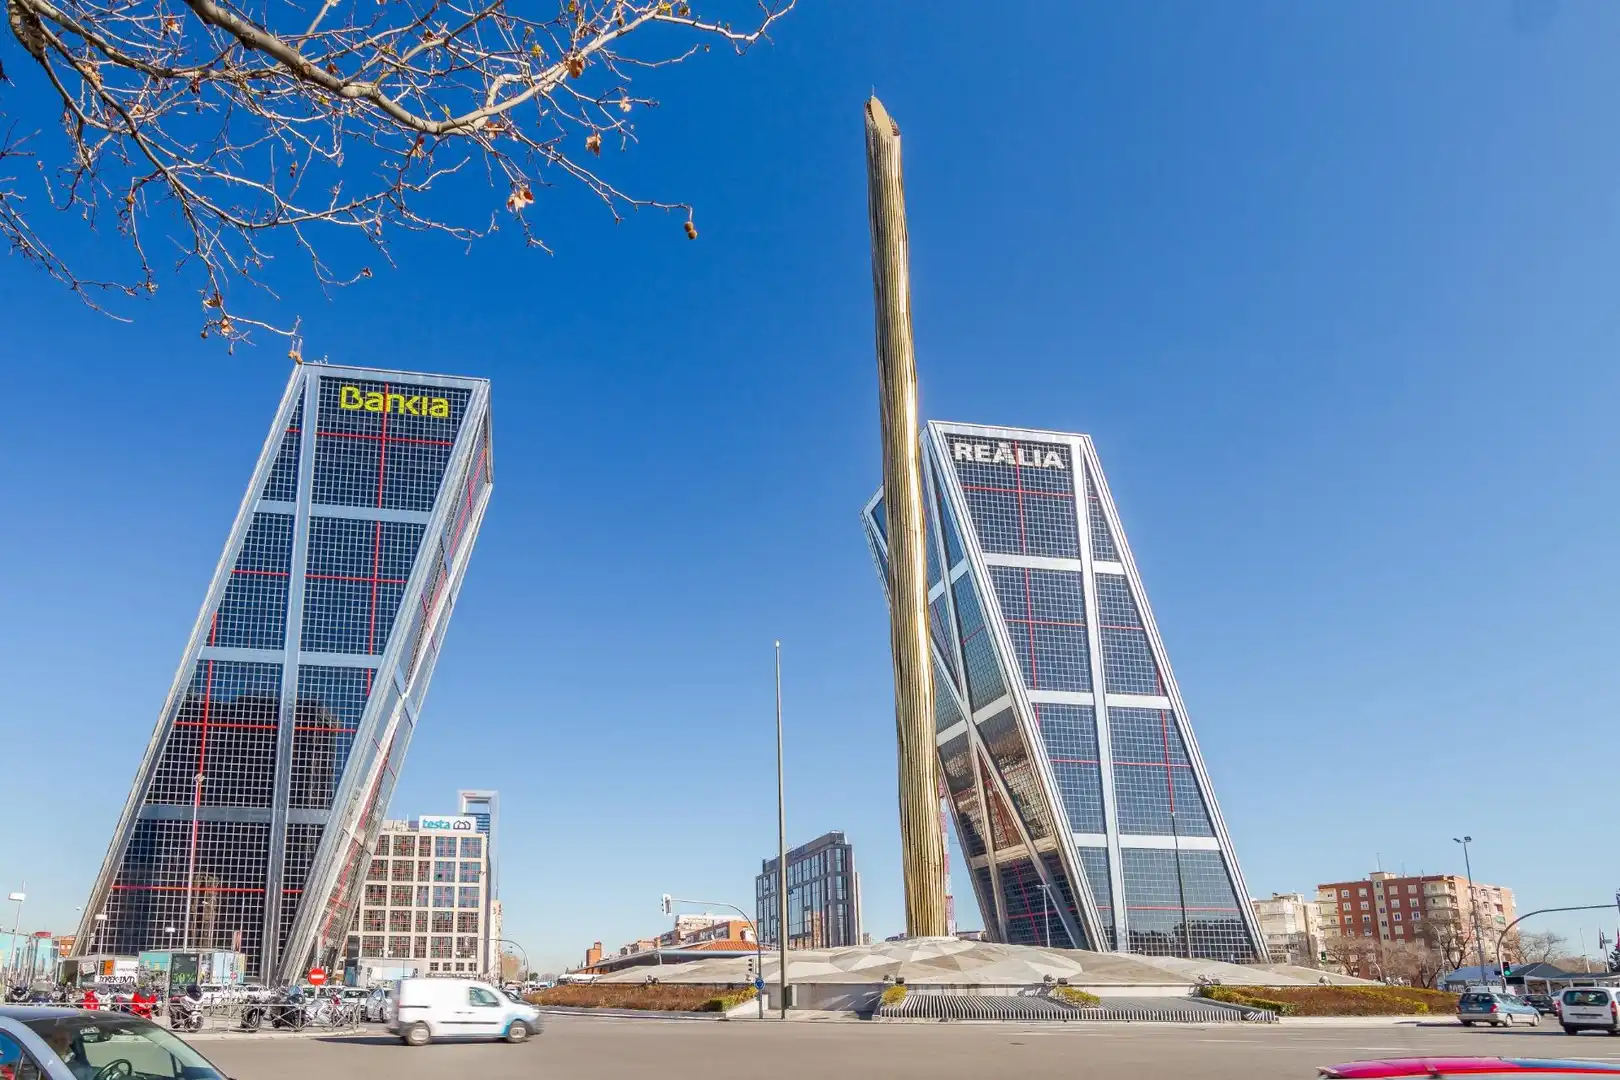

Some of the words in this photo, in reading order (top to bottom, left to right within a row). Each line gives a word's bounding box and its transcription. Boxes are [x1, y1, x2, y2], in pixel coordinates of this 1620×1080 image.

[340, 386, 449, 418] Bankia
[954, 442, 1065, 469] REALIA
[422, 819, 451, 830] testa
